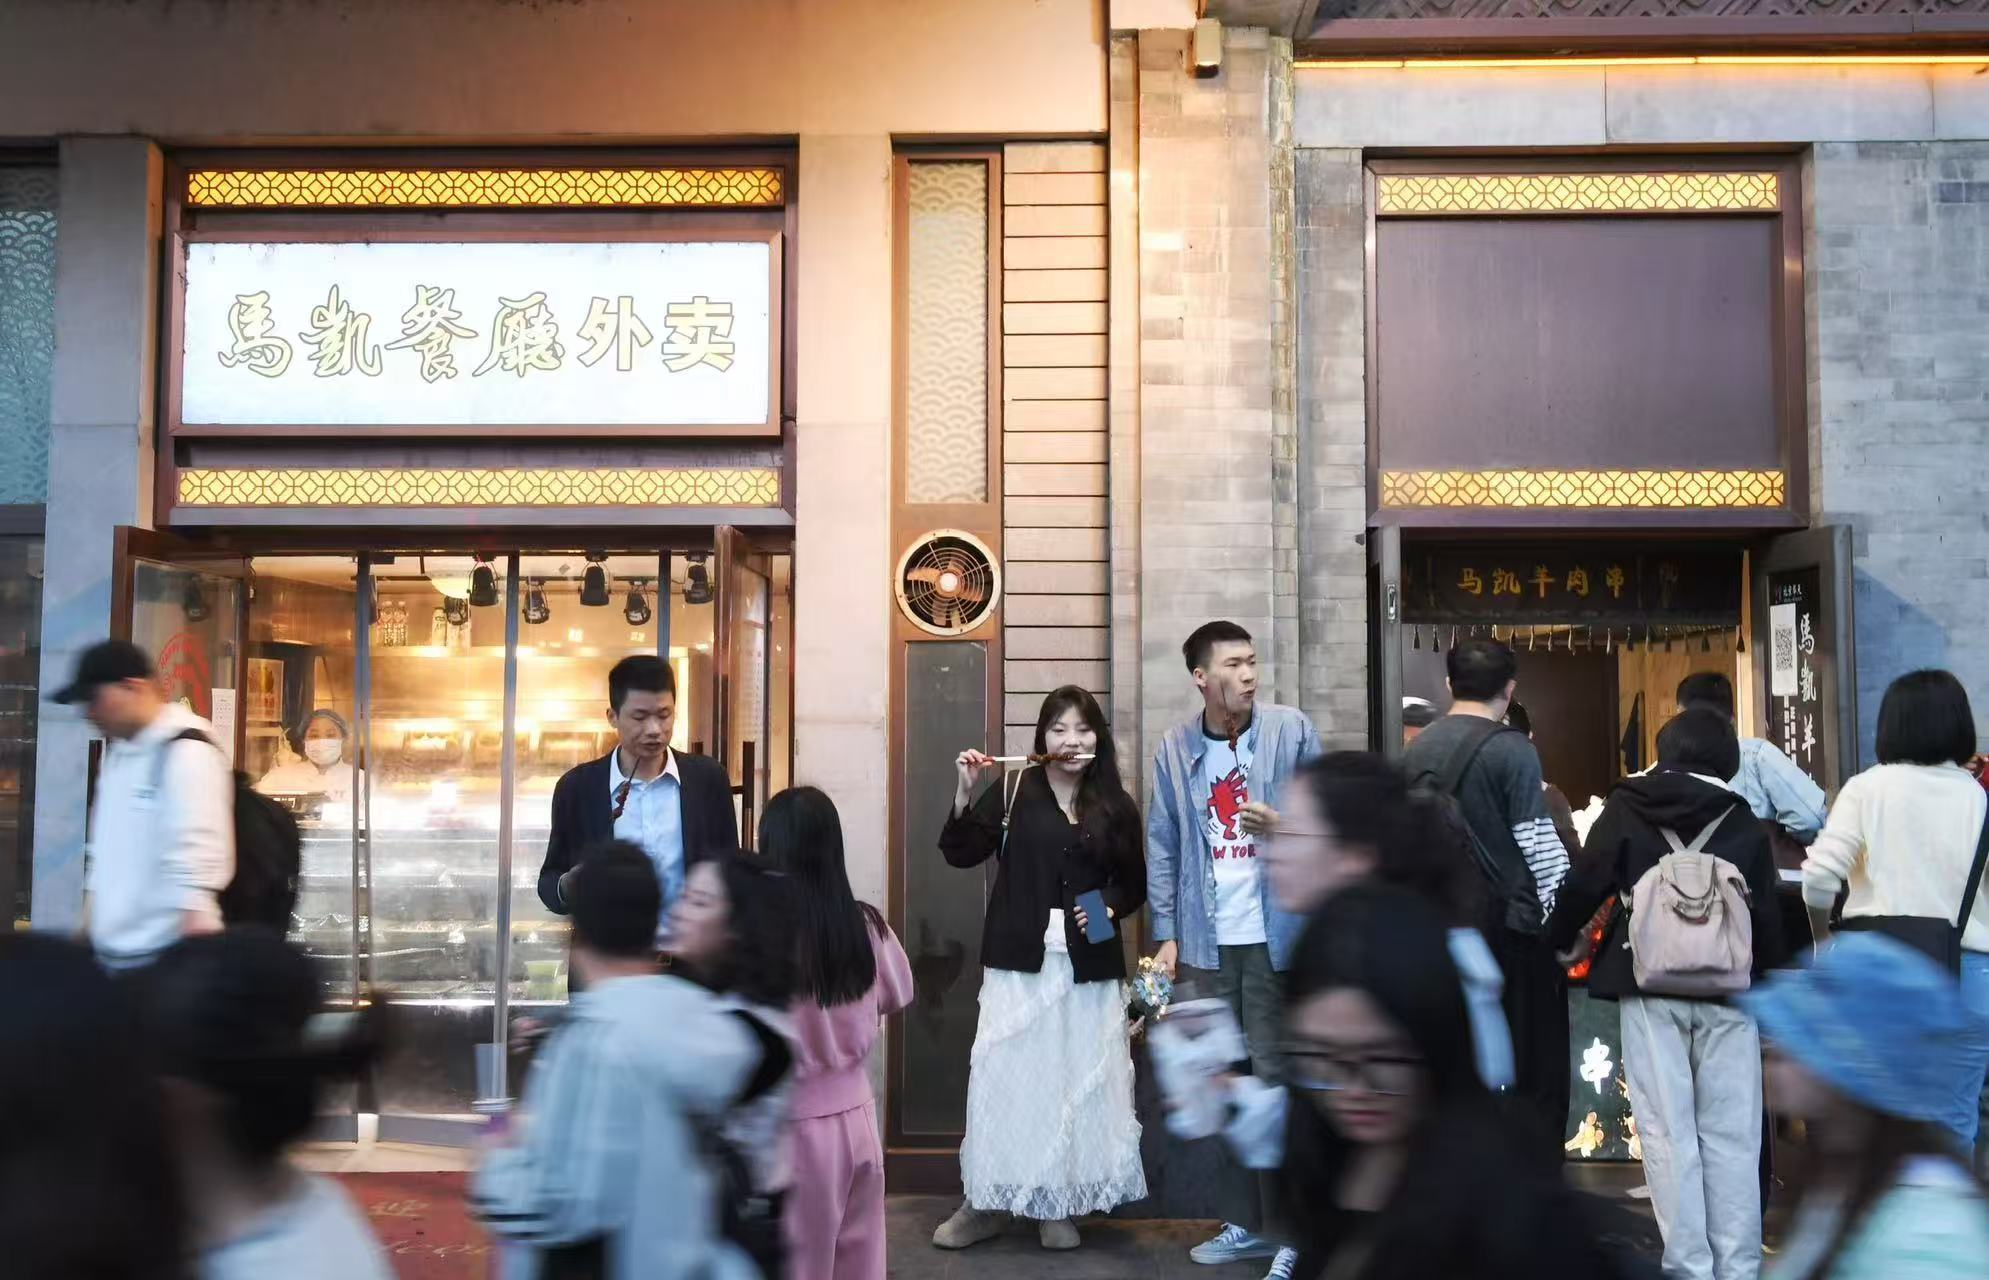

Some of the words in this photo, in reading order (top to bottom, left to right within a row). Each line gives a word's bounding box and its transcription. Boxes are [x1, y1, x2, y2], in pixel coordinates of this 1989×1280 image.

[1457, 564, 1625, 598] 马凯羊肉串
[1798, 612, 1816, 781] 馬凱羊
[1579, 1036, 1613, 1095] 串
